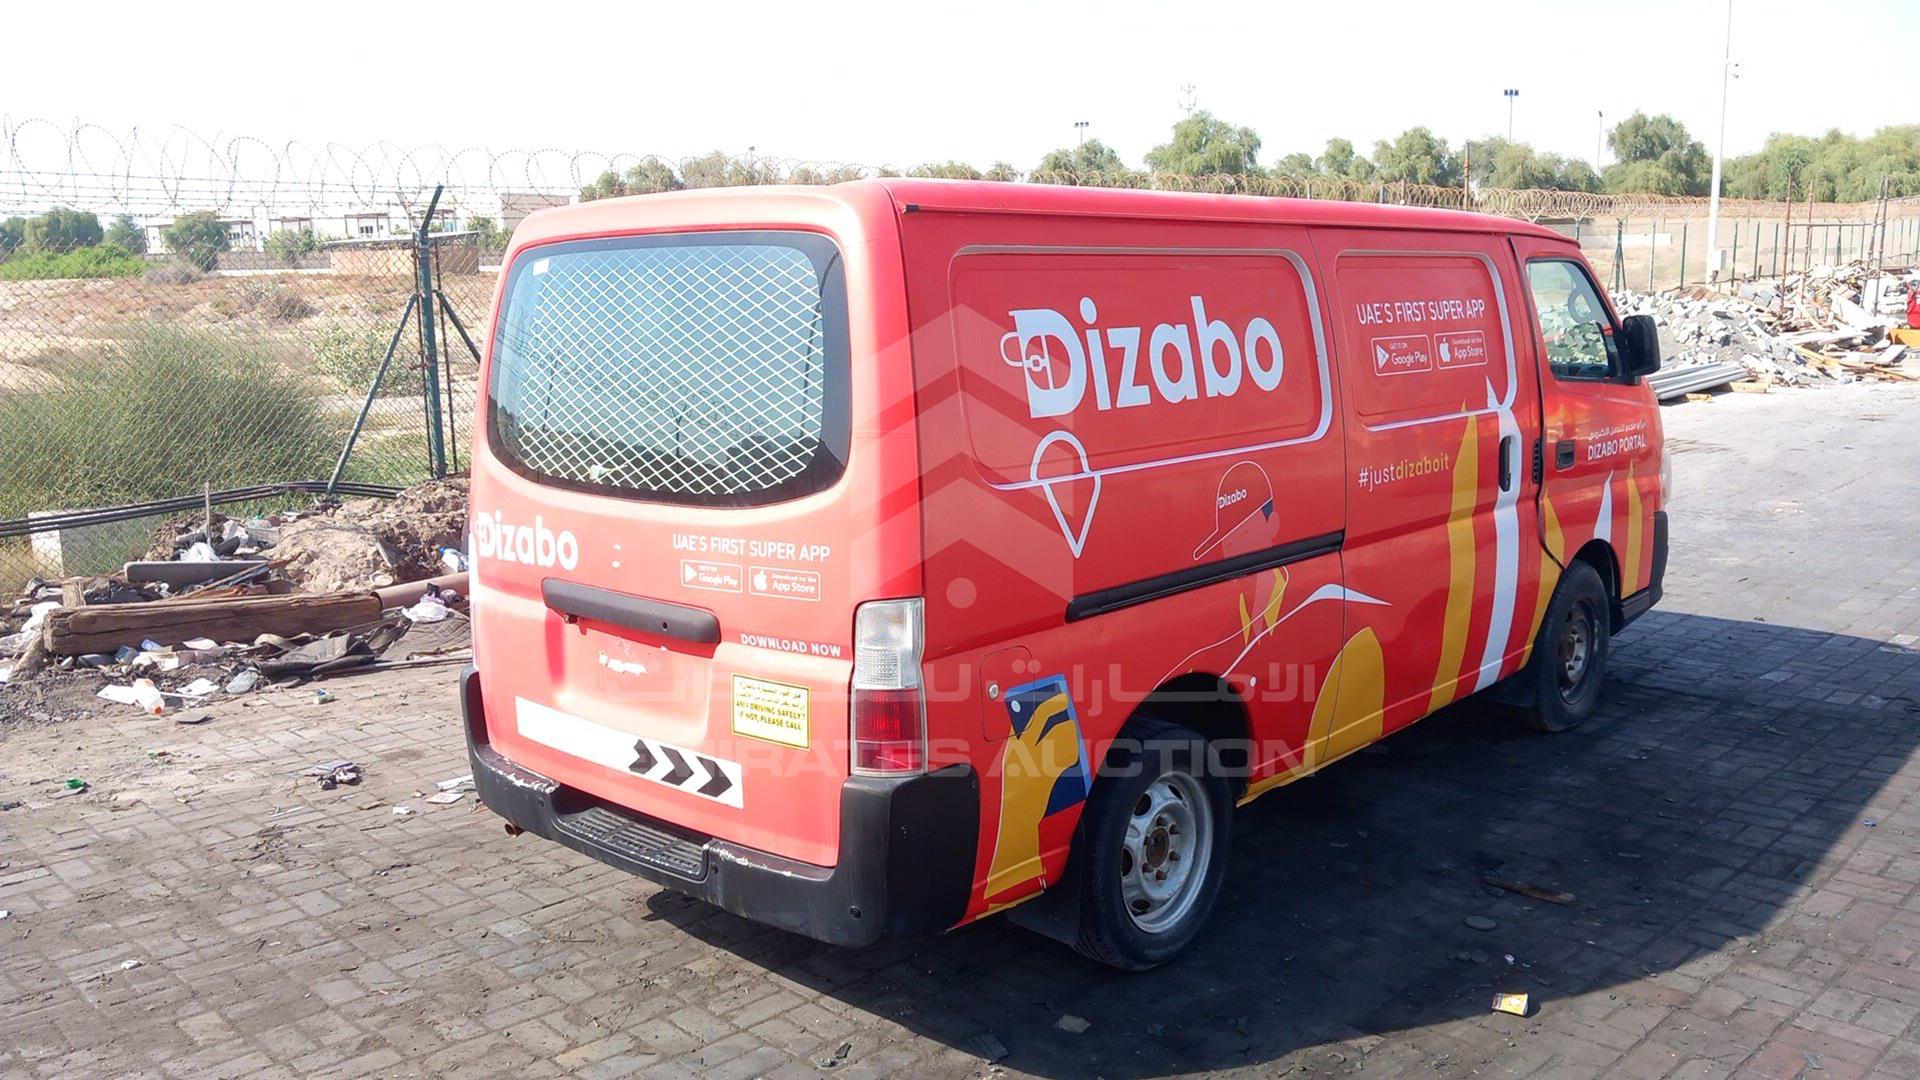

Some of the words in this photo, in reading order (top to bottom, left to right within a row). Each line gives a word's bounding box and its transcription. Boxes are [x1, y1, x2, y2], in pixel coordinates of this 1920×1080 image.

[1356, 303, 1394, 325] UAE'S
[1395, 301, 1427, 322] FIRST
[1429, 300, 1465, 321] SUPER
[1466, 299, 1486, 319] APP
[1000, 296, 1284, 419] Dizabo
[1392, 351, 1415, 367] Google
[1415, 351, 1428, 364] Play
[1454, 346, 1467, 360] App
[1467, 345, 1484, 358] Store
[1587, 440, 1618, 461] DIZABO
[1619, 433, 1646, 453] PORTAL
[1358, 452, 1450, 492] #justdizaboit
[1218, 488, 1248, 509] Dizabo
[475, 509, 579, 571] Dizabo
[672, 533, 707, 551] UAE'S
[710, 537, 746, 556] FIRST
[749, 541, 796, 560] SUPER
[799, 544, 831, 562] APP
[699, 572, 723, 586] Google
[723, 575, 738, 588] Play
[772, 579, 790, 593] App
[790, 582, 816, 594] Store
[740, 633, 807, 654] DOWNLOAD
[811, 643, 842, 658] NOW
[750, 703, 775, 715] DRIVING
[760, 716, 784, 727] PLEASE
[785, 721, 801, 730] CALL
